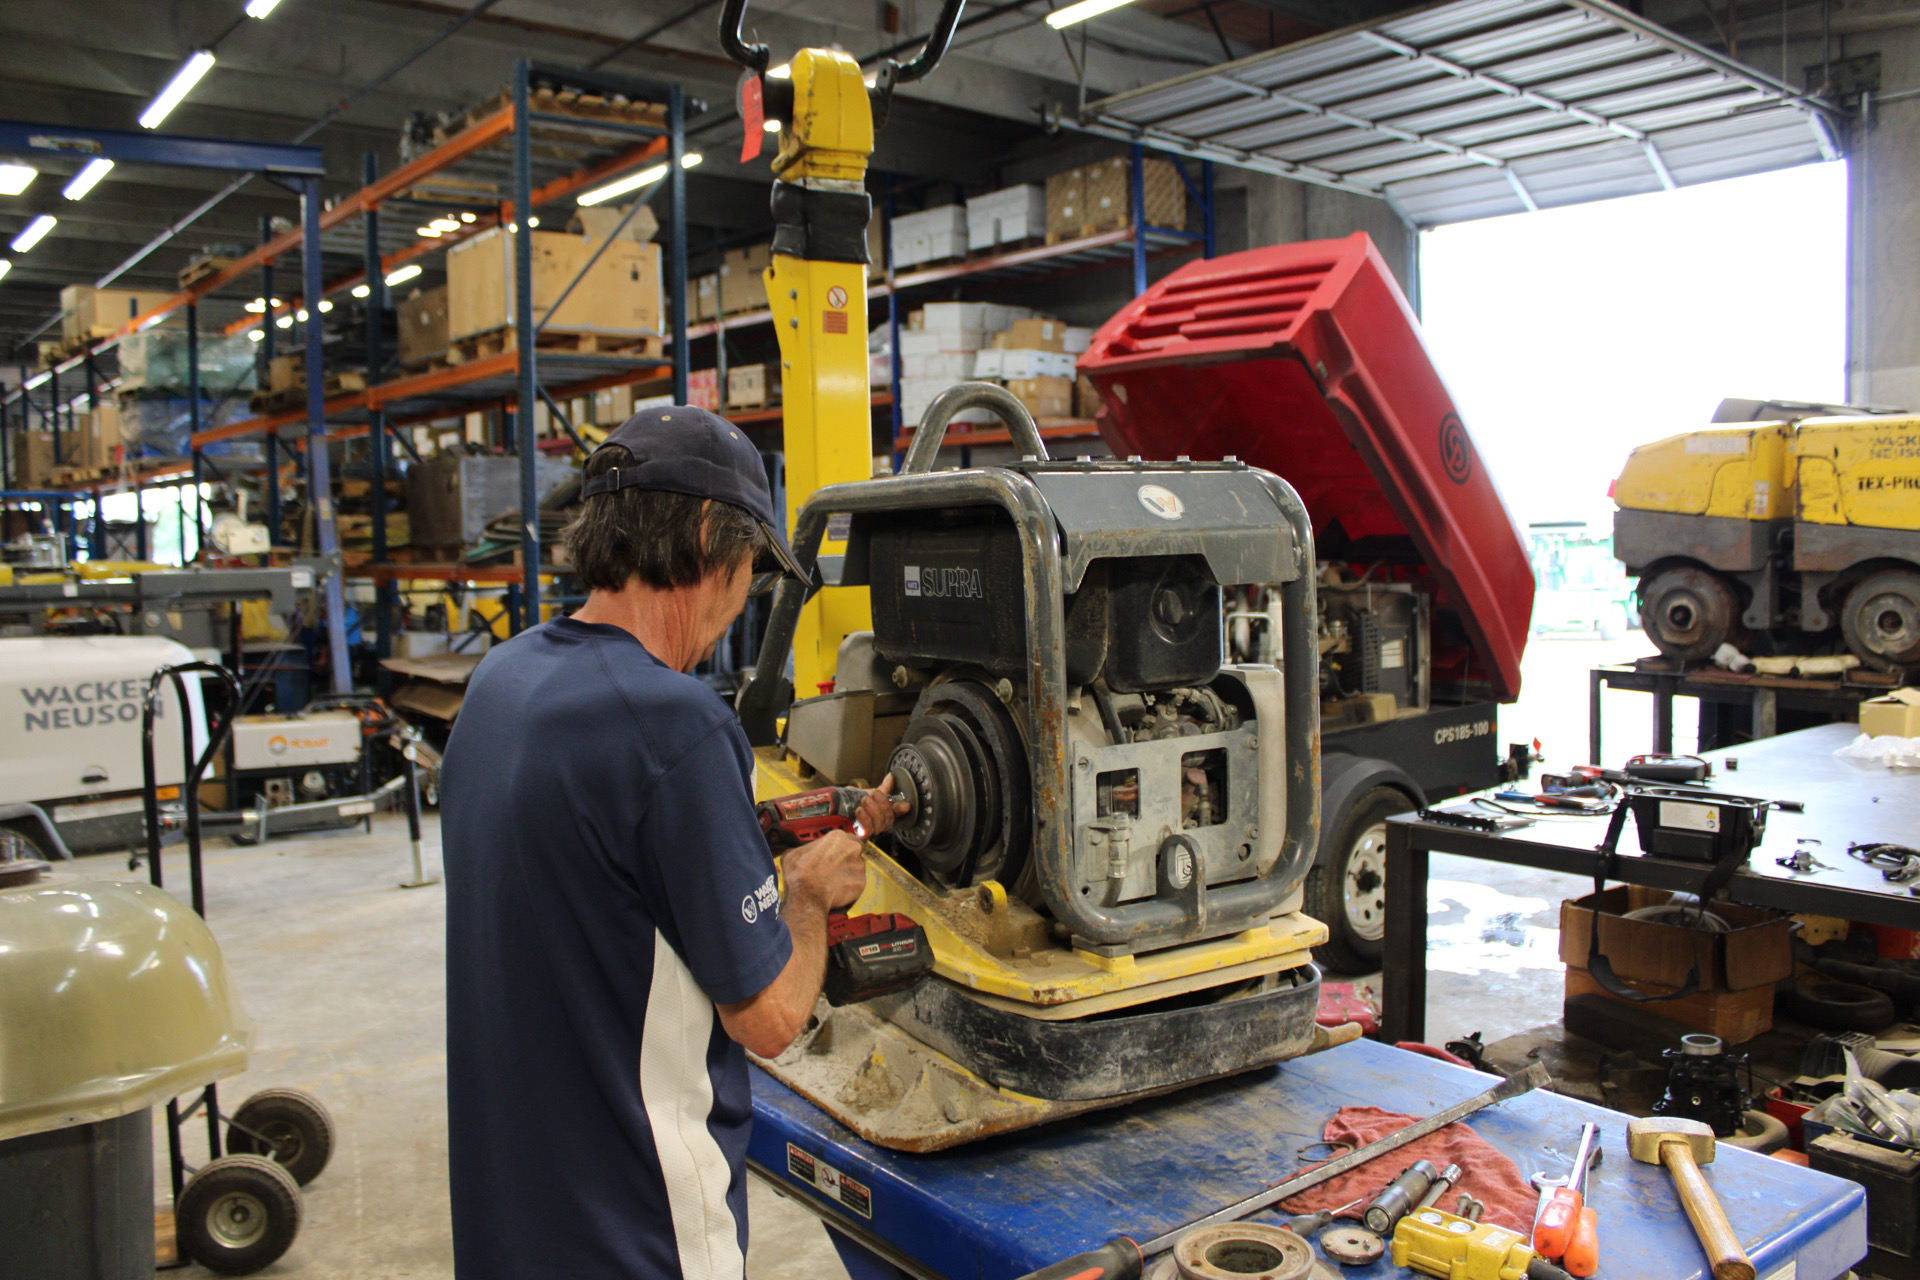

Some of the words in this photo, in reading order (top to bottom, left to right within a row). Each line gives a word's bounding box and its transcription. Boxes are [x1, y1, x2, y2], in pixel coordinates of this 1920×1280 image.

[1870, 435, 1920, 447] WACK
[922, 567, 983, 598] SUPRA
[1434, 720, 1489, 745] CPS185-100
